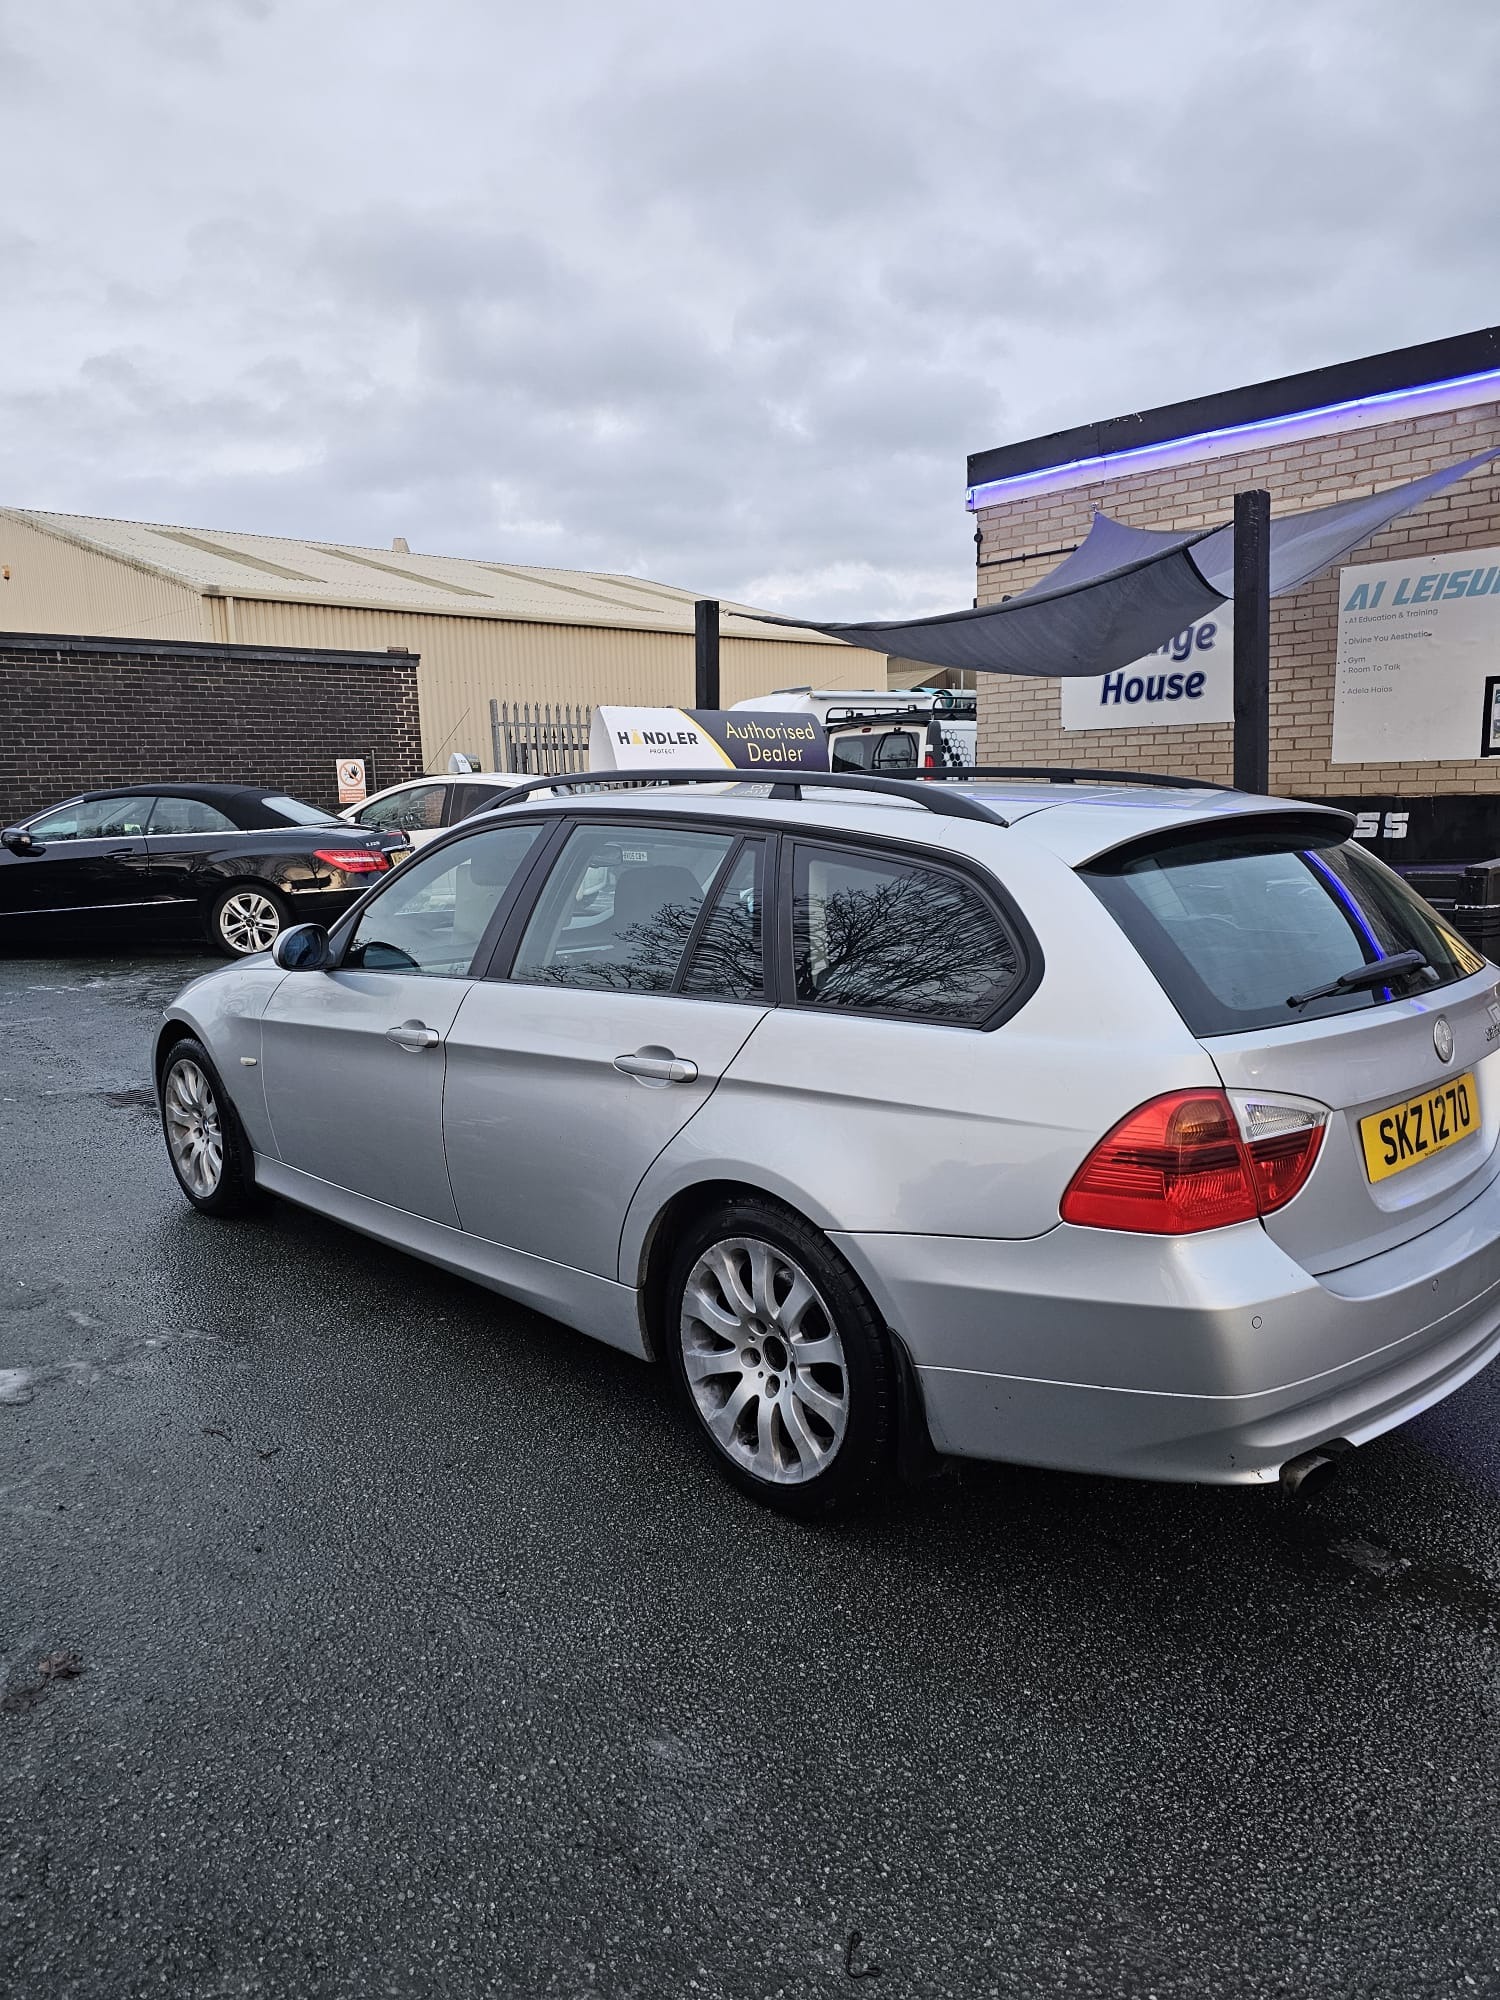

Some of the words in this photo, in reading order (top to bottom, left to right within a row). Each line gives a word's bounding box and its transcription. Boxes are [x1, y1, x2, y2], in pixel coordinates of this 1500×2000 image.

[1358, 613, 1397, 624] Education
[1398, 611, 1404, 619] &
[1406, 608, 1439, 617] Training
[1348, 636, 1372, 645] Divine
[1347, 656, 1366, 664] Gym
[1384, 663, 1401, 671] Talk
[1101, 671, 1207, 705] House
[726, 720, 816, 740] Authorised
[747, 742, 803, 762] Dealer
